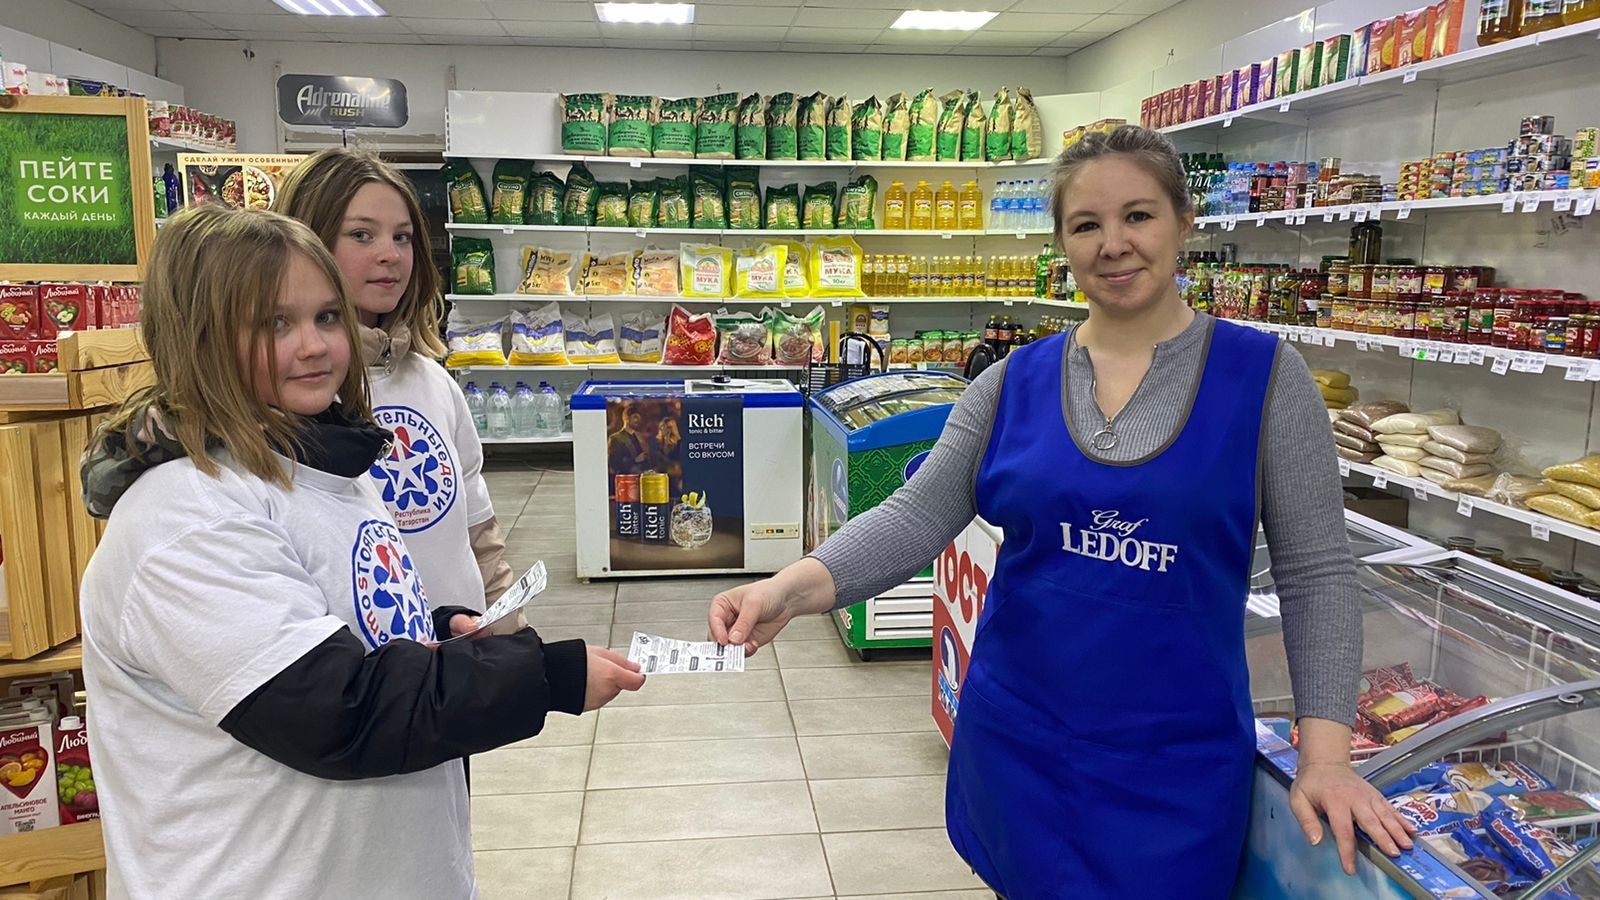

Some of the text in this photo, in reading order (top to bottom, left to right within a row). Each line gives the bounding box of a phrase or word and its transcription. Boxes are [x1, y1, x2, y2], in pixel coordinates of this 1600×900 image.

[297, 84, 391, 116] Adrenaline
[330, 107, 364, 117] RUSH
[184, 155, 218, 163] СДЕЛАЙ
[19, 156, 114, 180] ПЕЙТЕ
[27, 184, 110, 204] СОКИ
[23, 210, 116, 222] КАЖДЫЙ ДЕНЬ!
[696, 276, 719, 284] МУКА
[43, 287, 80, 299] Любимый
[688, 413, 724, 428] Rich
[688, 442, 725, 450] ВСТРЕЧИ
[688, 451, 735, 459] СО ВКУСОМ
[394, 508, 432, 519] Республика
[620, 504, 631, 534] Rich
[397, 517, 430, 527] Татарстан
[645, 506, 658, 539] Rich
[658, 516, 666, 539] tonic
[1089, 509, 1149, 537] Graf
[1059, 522, 1178, 572] LEDOFF
[0, 798, 47, 811] АПЕЛЬСИНОВОЕ
[14, 806, 36, 815] МАНГО
